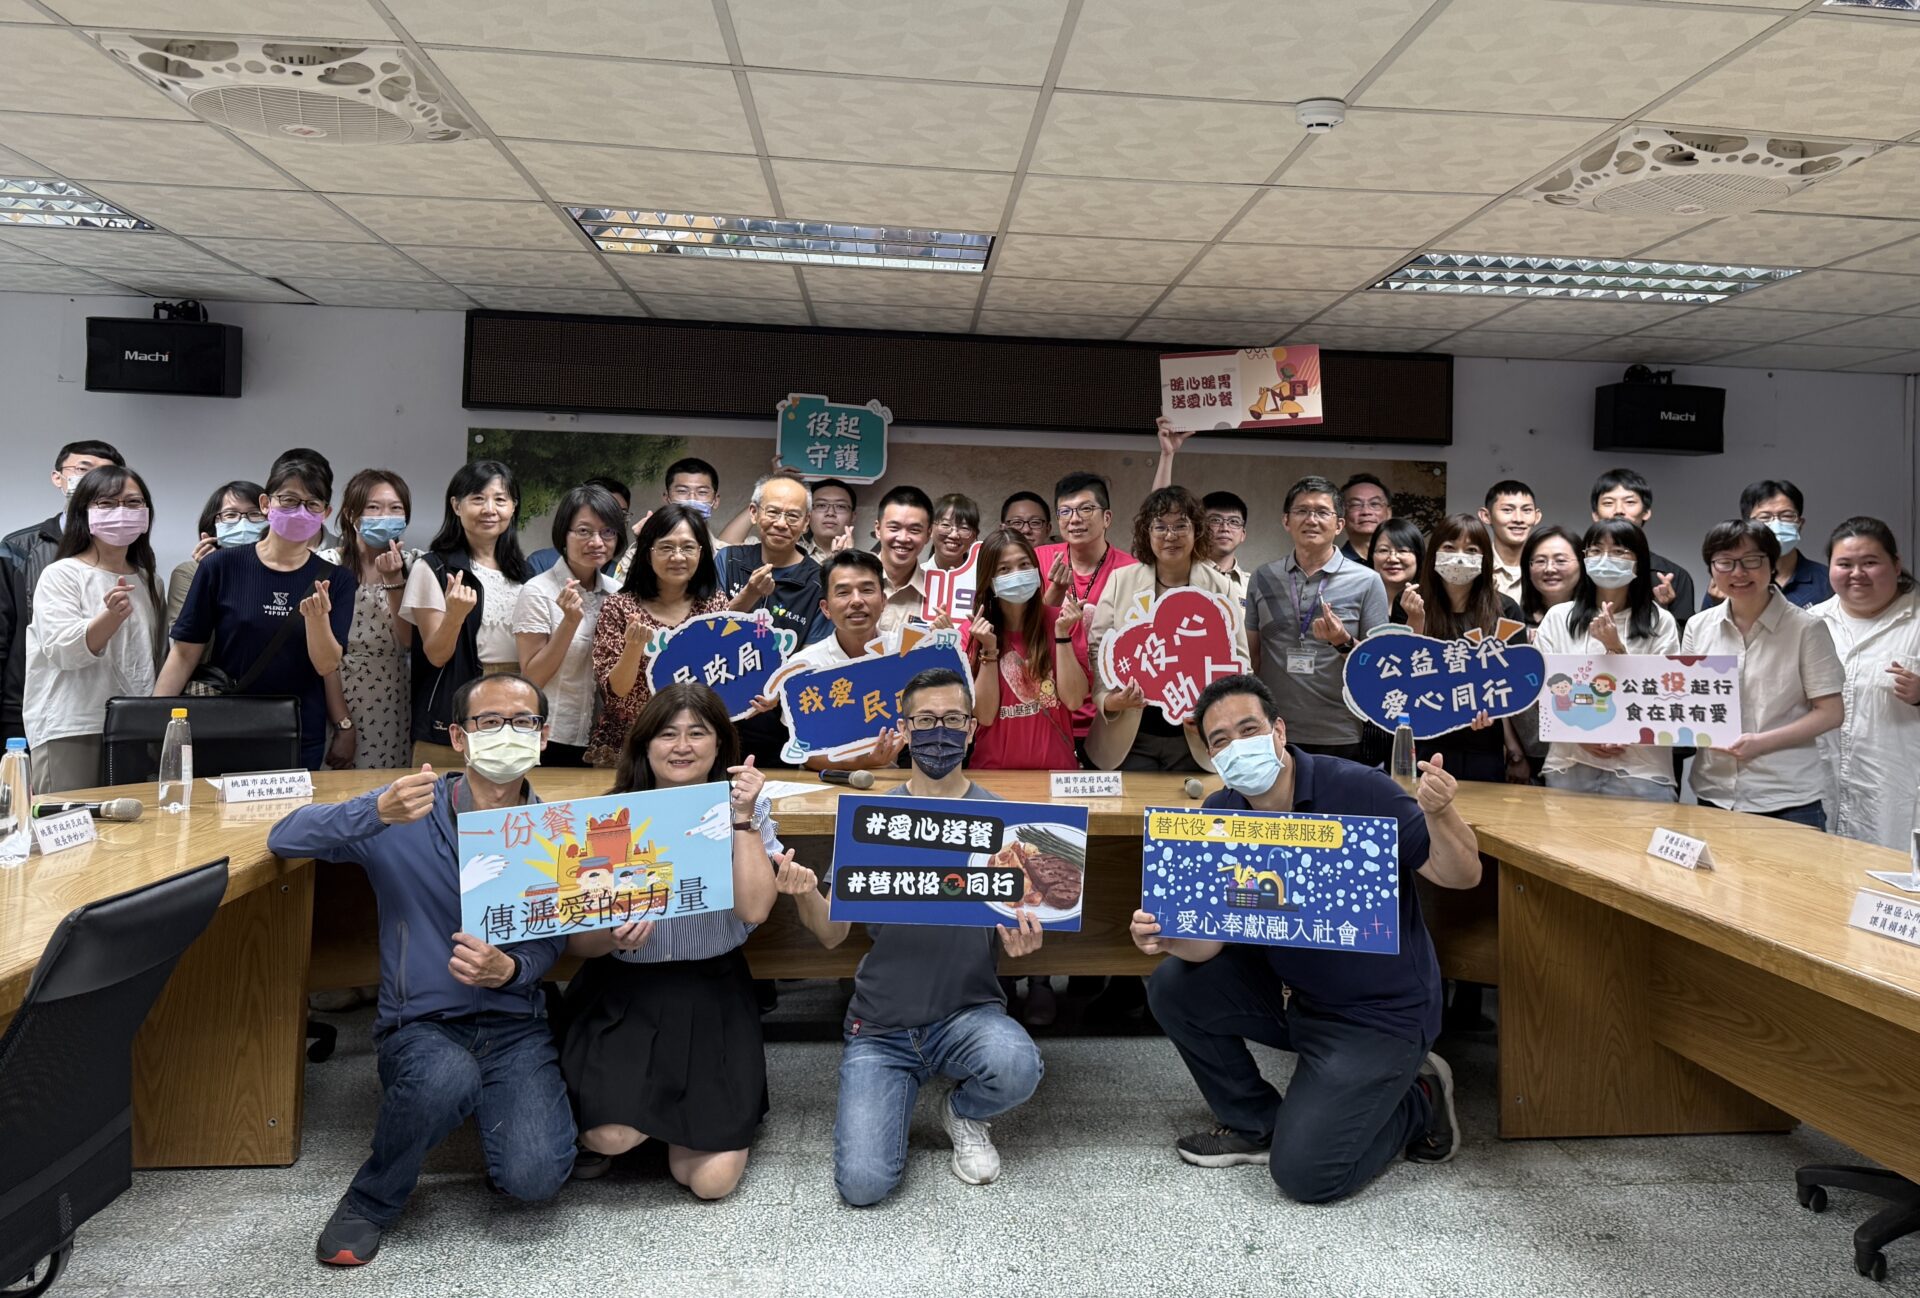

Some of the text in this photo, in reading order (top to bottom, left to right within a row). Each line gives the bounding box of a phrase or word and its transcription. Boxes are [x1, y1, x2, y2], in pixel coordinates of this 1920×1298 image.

[124, 350, 171, 362] Machi
[1170, 374, 1231, 392] 暖心暖胃
[1171, 392, 1233, 409] 送愛心餐
[806, 411, 862, 441] 役起
[1660, 411, 1697, 422] Machi
[806, 441, 860, 472] 守護
[1376, 638, 1510, 679] 公益替代
[1621, 671, 1734, 697] 公益役起行
[798, 677, 904, 724] 我愛民
[1381, 678, 1513, 720] 愛心同行
[1625, 702, 1729, 724] 食在真有愛
[231, 775, 306, 788] 桃園市政府民政局
[1055, 775, 1119, 785] 桃園市政府民政局
[459, 802, 578, 849] 一份餐
[865, 813, 994, 849] #愛心送餐
[1156, 816, 1336, 843] 替代役 居家清潔服務
[480, 876, 709, 944] 傳遞愛的力量
[1176, 909, 1360, 947] 愛心奉獻融入社會
